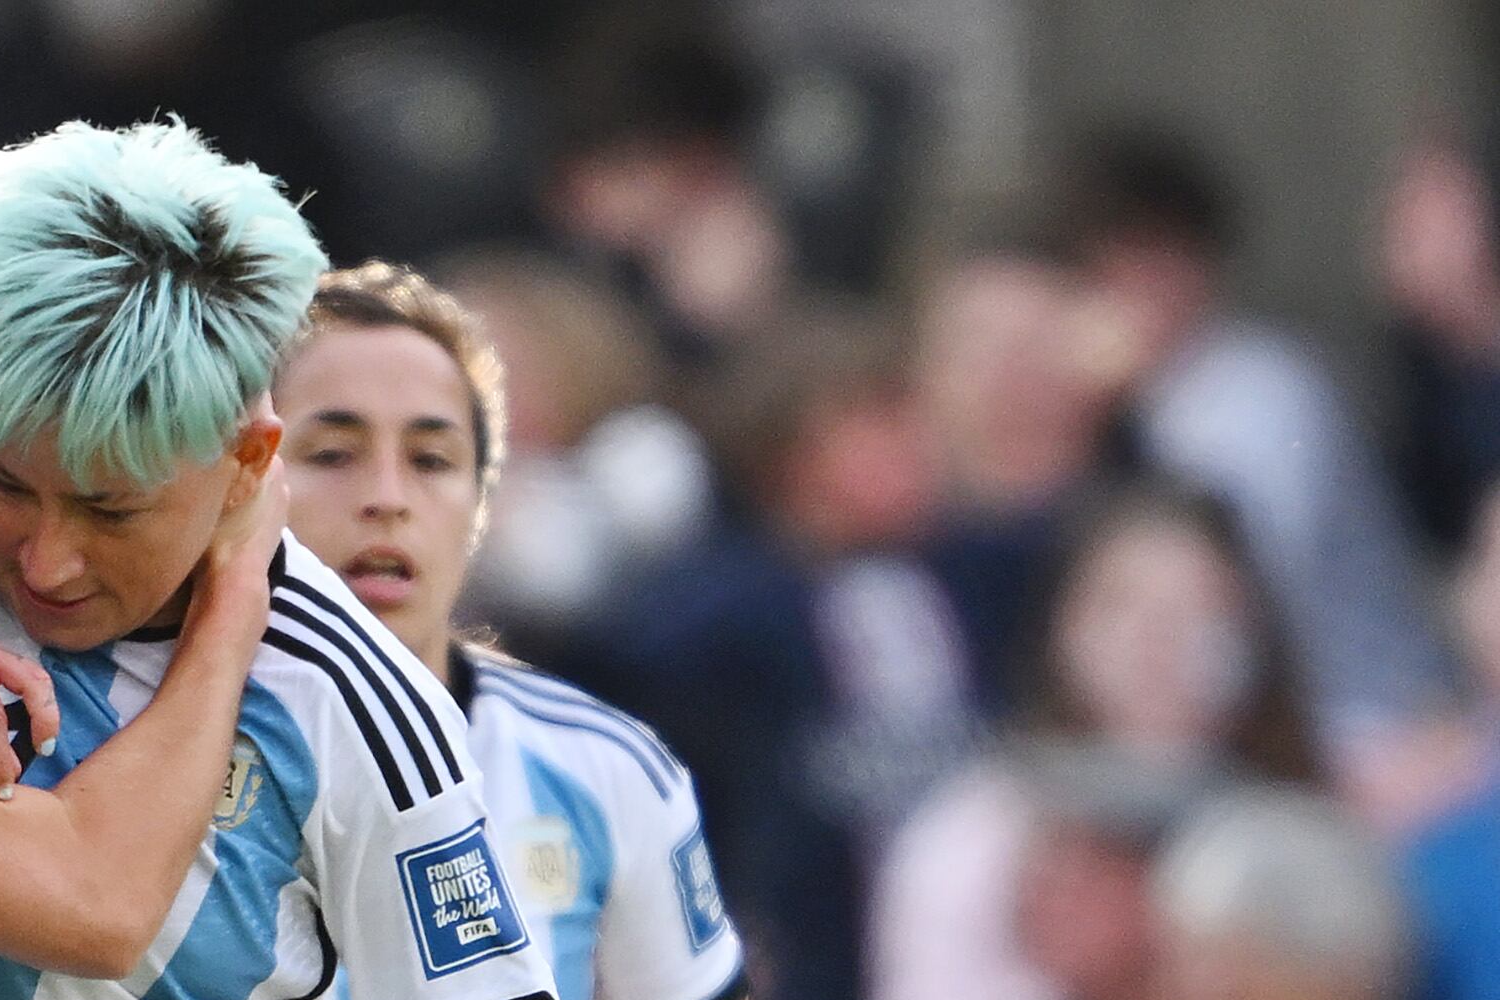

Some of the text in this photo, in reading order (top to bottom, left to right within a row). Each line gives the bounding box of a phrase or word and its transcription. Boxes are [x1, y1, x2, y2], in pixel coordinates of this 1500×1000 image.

[426, 848, 485, 882] FOOTBALL
[430, 866, 491, 906] UNITES
[432, 887, 501, 928] the World
[463, 923, 491, 938] FIFA
